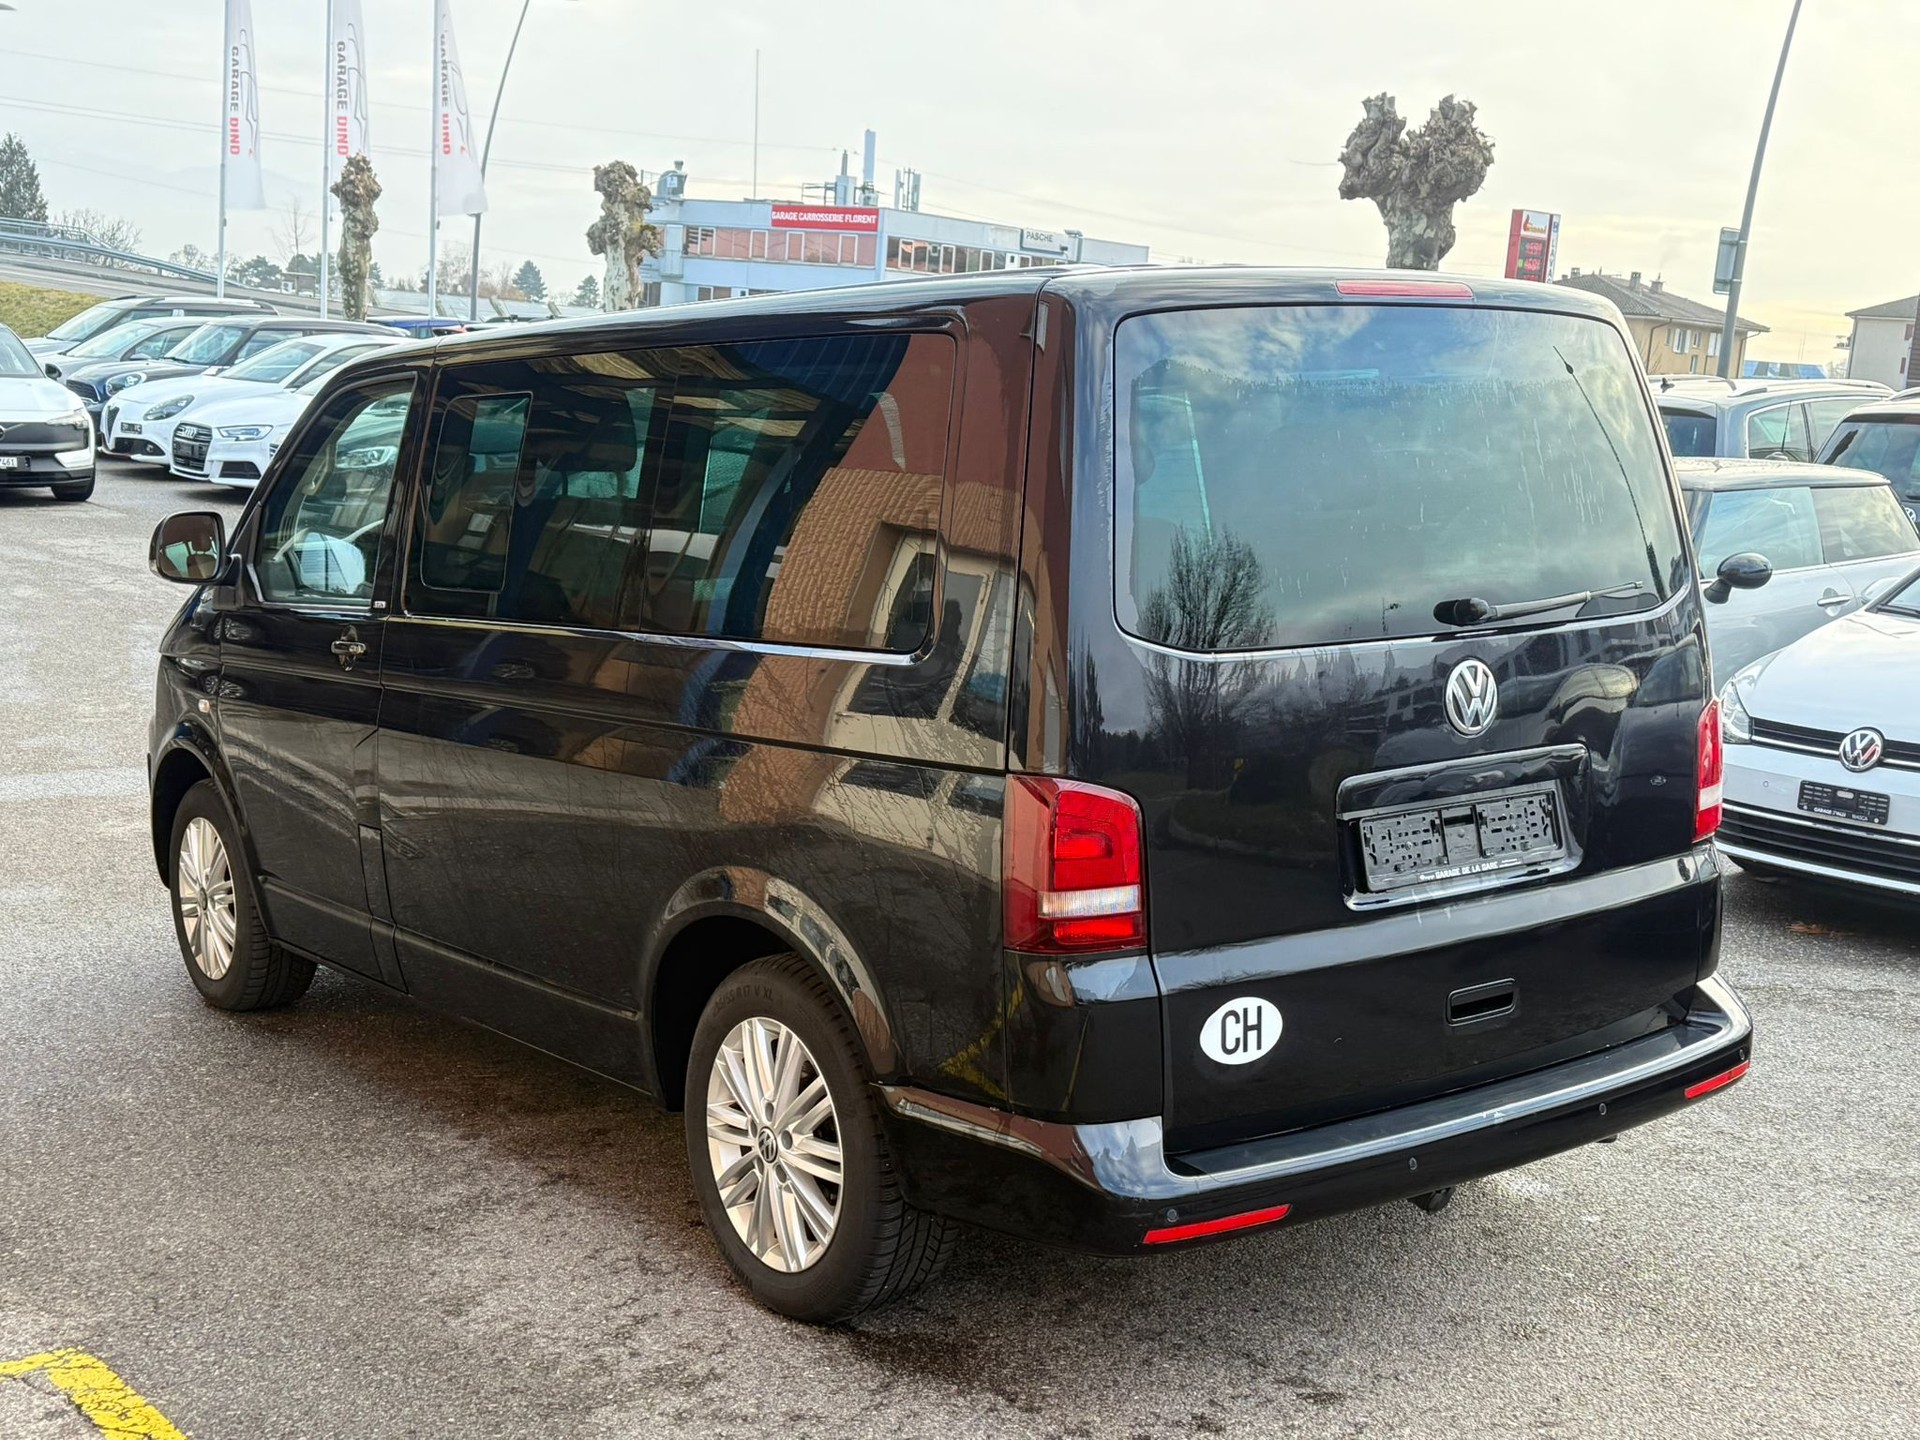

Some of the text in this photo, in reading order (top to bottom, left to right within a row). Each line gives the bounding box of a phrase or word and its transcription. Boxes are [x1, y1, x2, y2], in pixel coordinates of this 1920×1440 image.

[229, 46, 240, 156] GARAGE DIND
[336, 41, 349, 156] GARAGE DIND
[771, 211, 877, 224] GARAGE CARROSSERIE FLORENT
[1026, 231, 1053, 242] PASCHE
[0, 458, 15, 467] 461
[1435, 868, 1460, 879] GARAGE
[1461, 866, 1470, 875] DE
[1472, 864, 1481, 873] LA
[1482, 861, 1498, 871] GARE
[1221, 1005, 1262, 1055] CH
